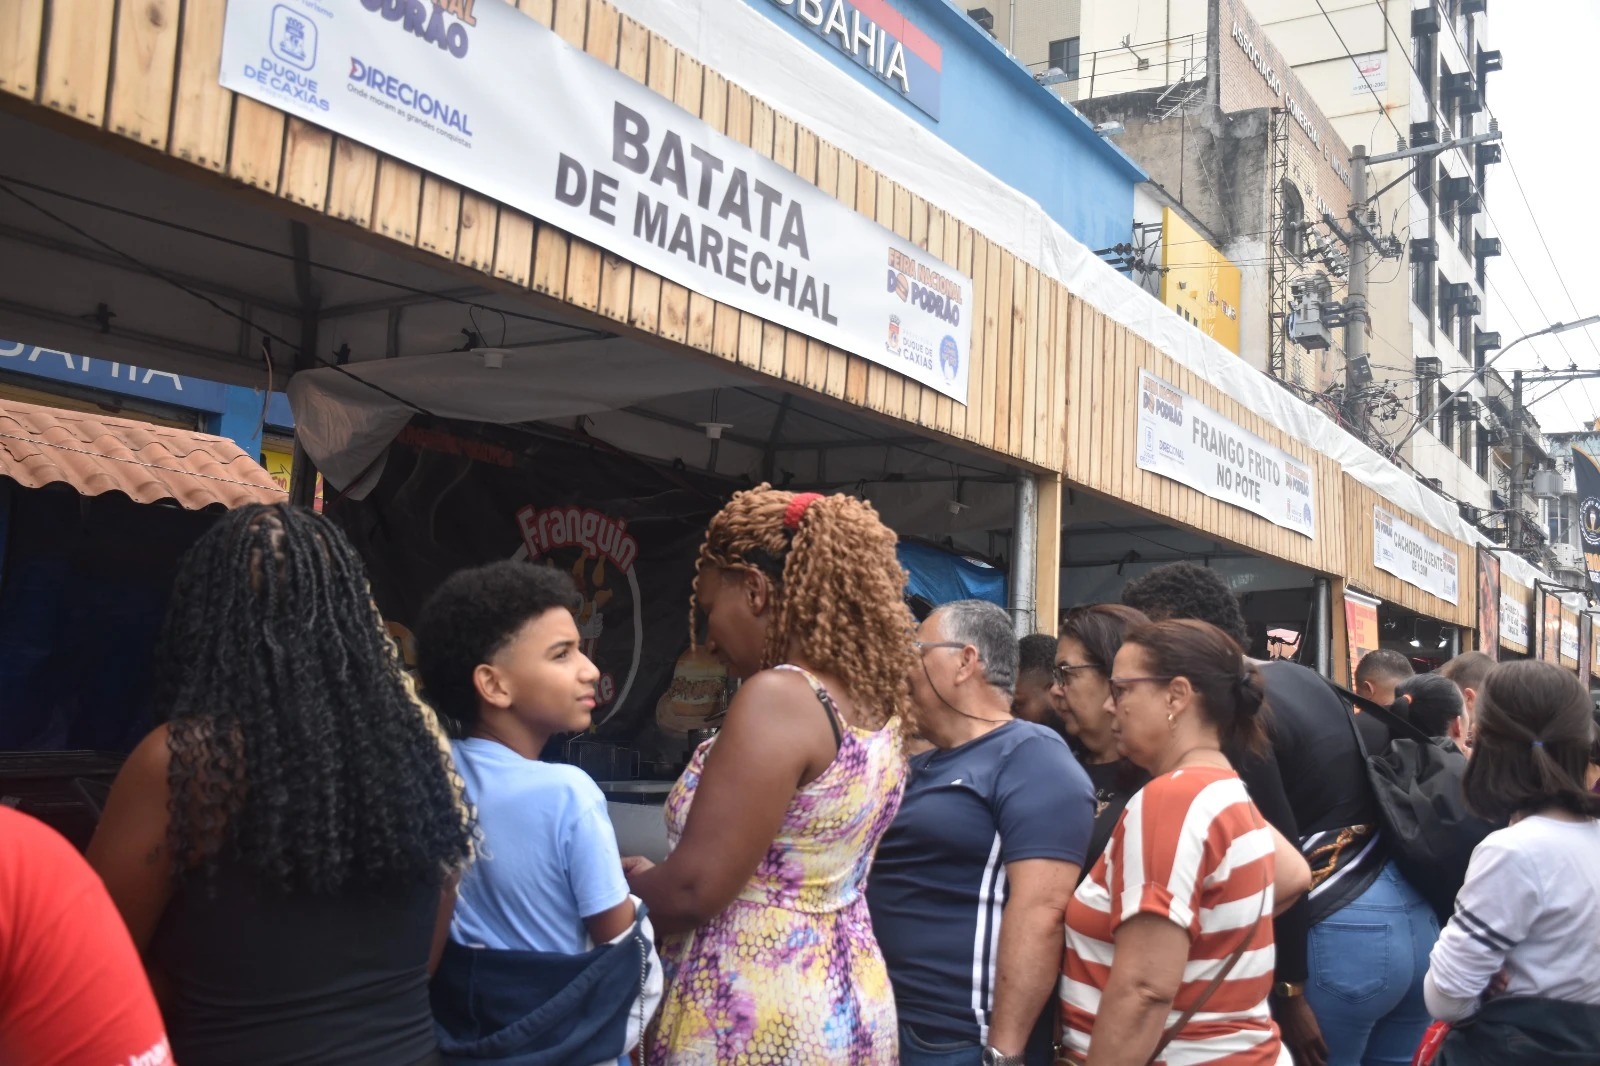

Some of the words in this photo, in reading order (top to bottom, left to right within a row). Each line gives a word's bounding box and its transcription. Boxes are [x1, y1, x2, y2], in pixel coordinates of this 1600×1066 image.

[244, 64, 268, 85] DE
[270, 77, 330, 112] CAXIAS
[260, 57, 318, 94] DUQUE
[349, 57, 473, 137] DIRECIONAL
[346, 82, 369, 100] Onde
[369, 94, 396, 113] moram
[397, 108, 406, 118] as
[406, 112, 435, 132] grandes
[435, 126, 472, 149] conquistas
[1285, 92, 1320, 152] COMERCIAL
[1323, 143, 1329, 161] E
[612, 100, 811, 262] BATATA
[554, 151, 620, 227] DE
[632, 190, 839, 327] MARECHAL
[888, 247, 916, 280] FEIRA
[917, 263, 963, 305] NACIONAL
[902, 336, 924, 354] DUQUE
[924, 345, 933, 358] DE
[902, 348, 933, 371] CAXIAS
[1192, 415, 1245, 468] FRANGO
[1248, 447, 1280, 487] FRITO
[1216, 462, 1232, 491] NO
[1235, 471, 1261, 504] POTE
[1393, 531, 1423, 561] CACHORRO
[1424, 549, 1443, 572] QUENTE
